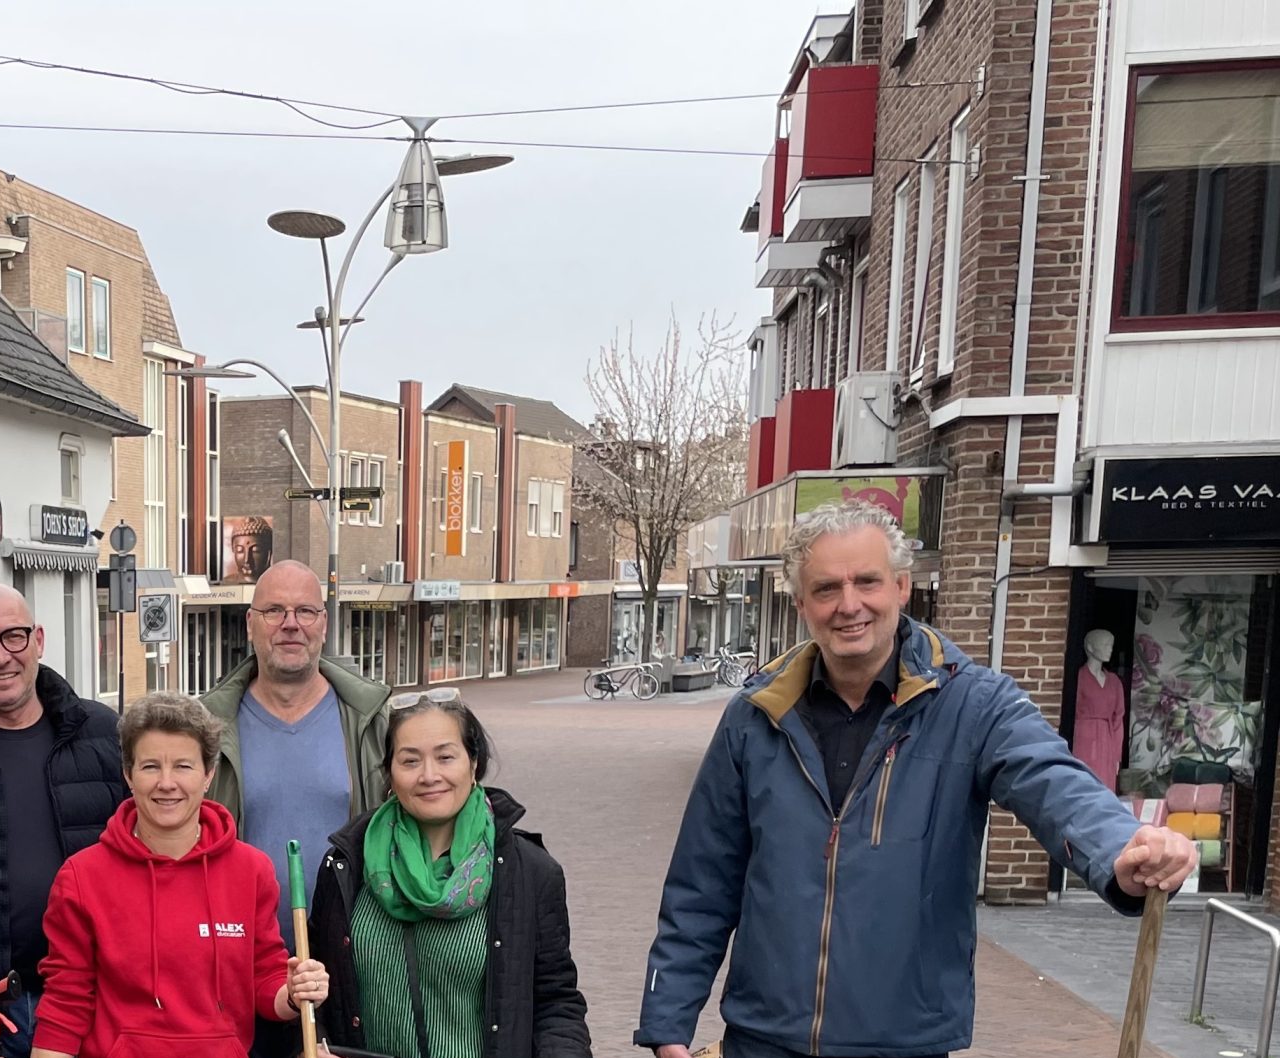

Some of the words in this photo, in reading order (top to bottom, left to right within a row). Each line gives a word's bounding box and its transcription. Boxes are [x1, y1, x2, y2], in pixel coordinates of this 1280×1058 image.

[1111, 485, 1218, 502] KLAAS
[1161, 502, 1188, 510] BED
[1194, 501, 1202, 509] &
[1211, 500, 1268, 509] TEXTIEL
[42, 512, 67, 540] JOHN'S
[67, 515, 87, 538] SHOP
[215, 922, 245, 933] ALEX
